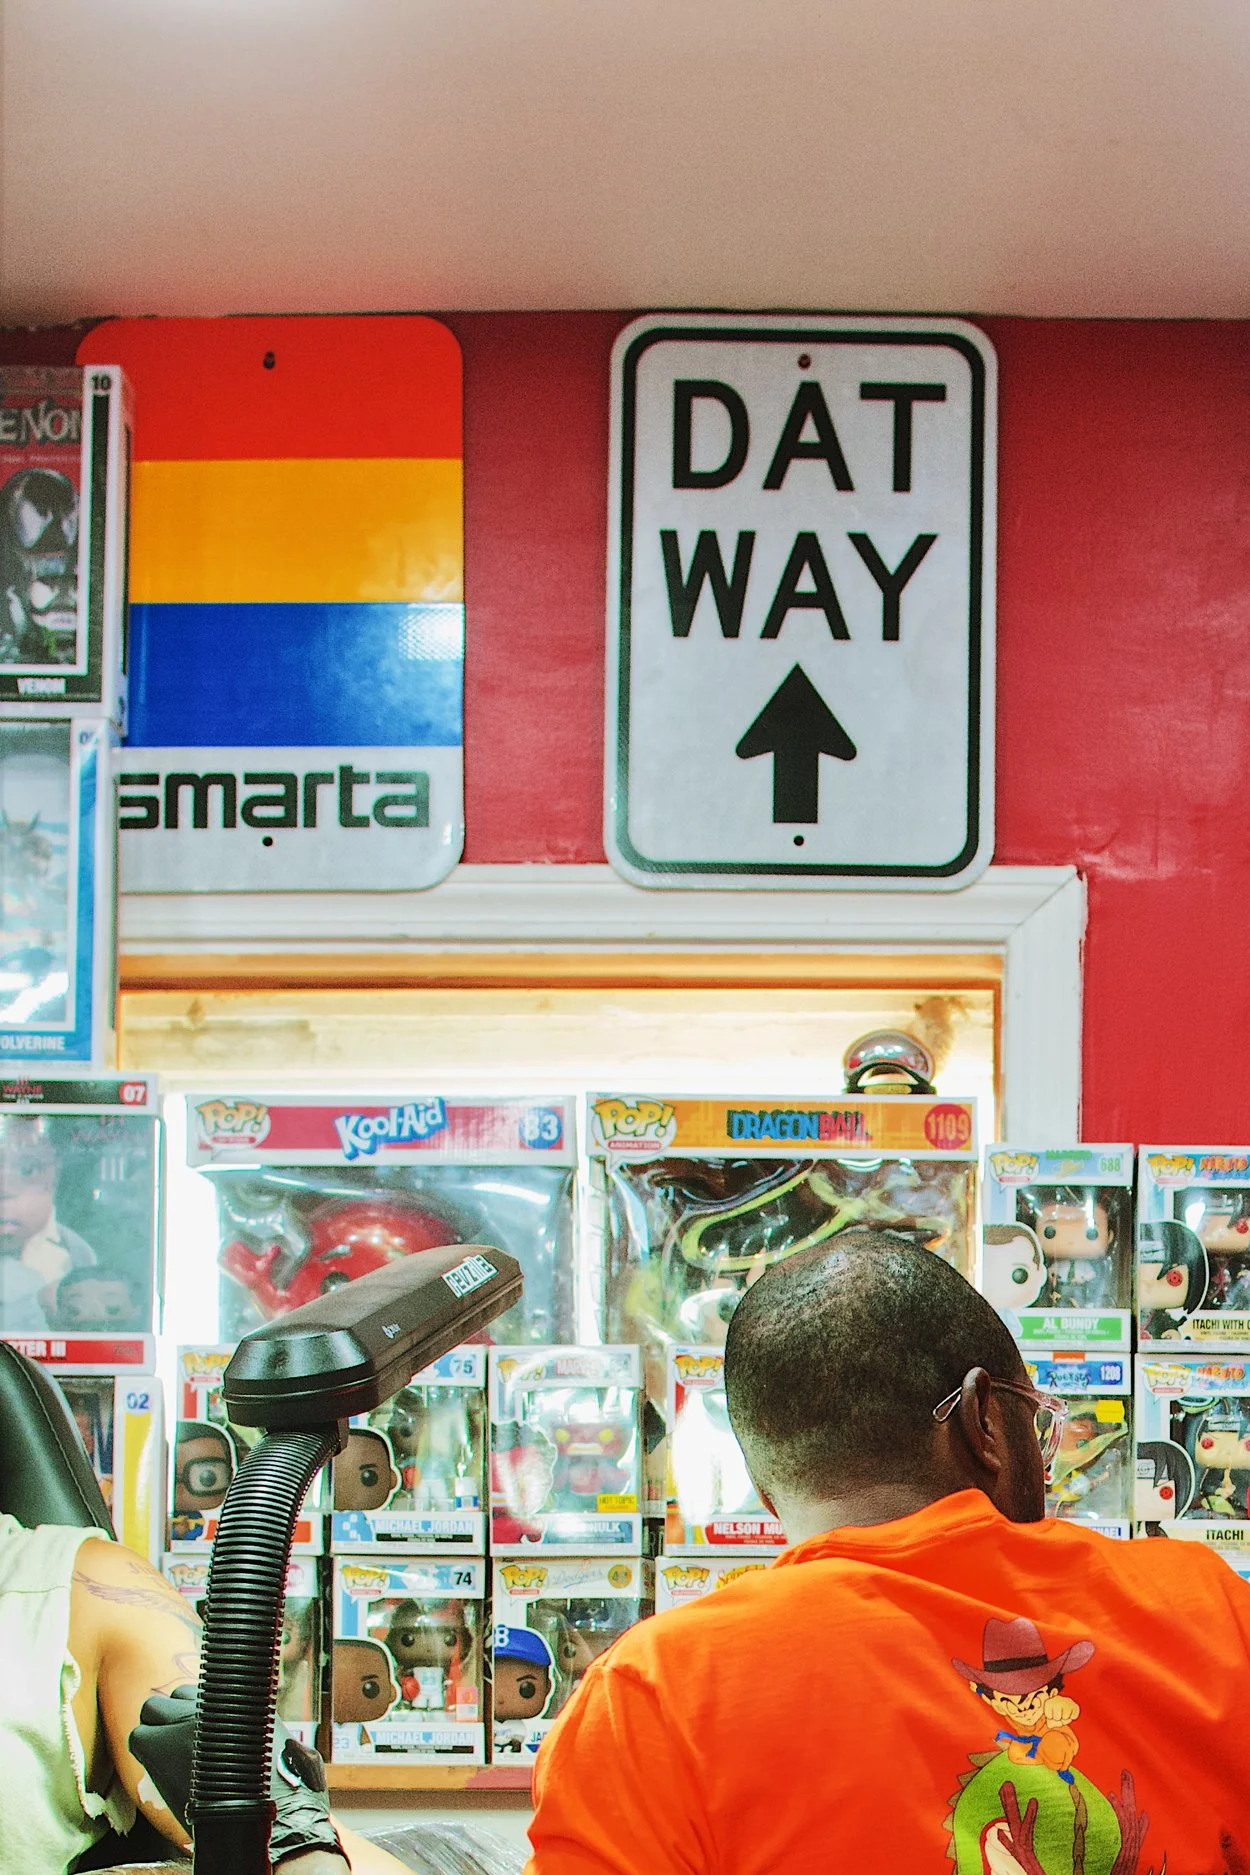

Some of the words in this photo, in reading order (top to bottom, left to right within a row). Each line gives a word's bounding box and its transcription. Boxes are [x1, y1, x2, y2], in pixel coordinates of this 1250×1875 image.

[673, 379, 947, 493] DAT
[659, 529, 938, 642] WAY
[0, 1036, 65, 1051] OLVERINE
[123, 1085, 145, 1102] 07
[596, 1100, 674, 1139] POP!
[928, 1114, 970, 1138] 1109
[196, 1101, 267, 1137] POP!
[337, 1098, 447, 1159] Kool-Aid
[1043, 1318, 1058, 1330] AL
[1062, 1318, 1100, 1330] BUNDY
[1191, 1318, 1220, 1331] ITACHI
[1222, 1319, 1244, 1331] WITH
[453, 1359, 473, 1375] 75
[374, 1520, 422, 1533] MICHAEL
[425, 1520, 473, 1534] JORDAN
[714, 1521, 758, 1536] NELSON
[1206, 1528, 1244, 1542] ITACHI
[454, 1571, 472, 1587] 74
